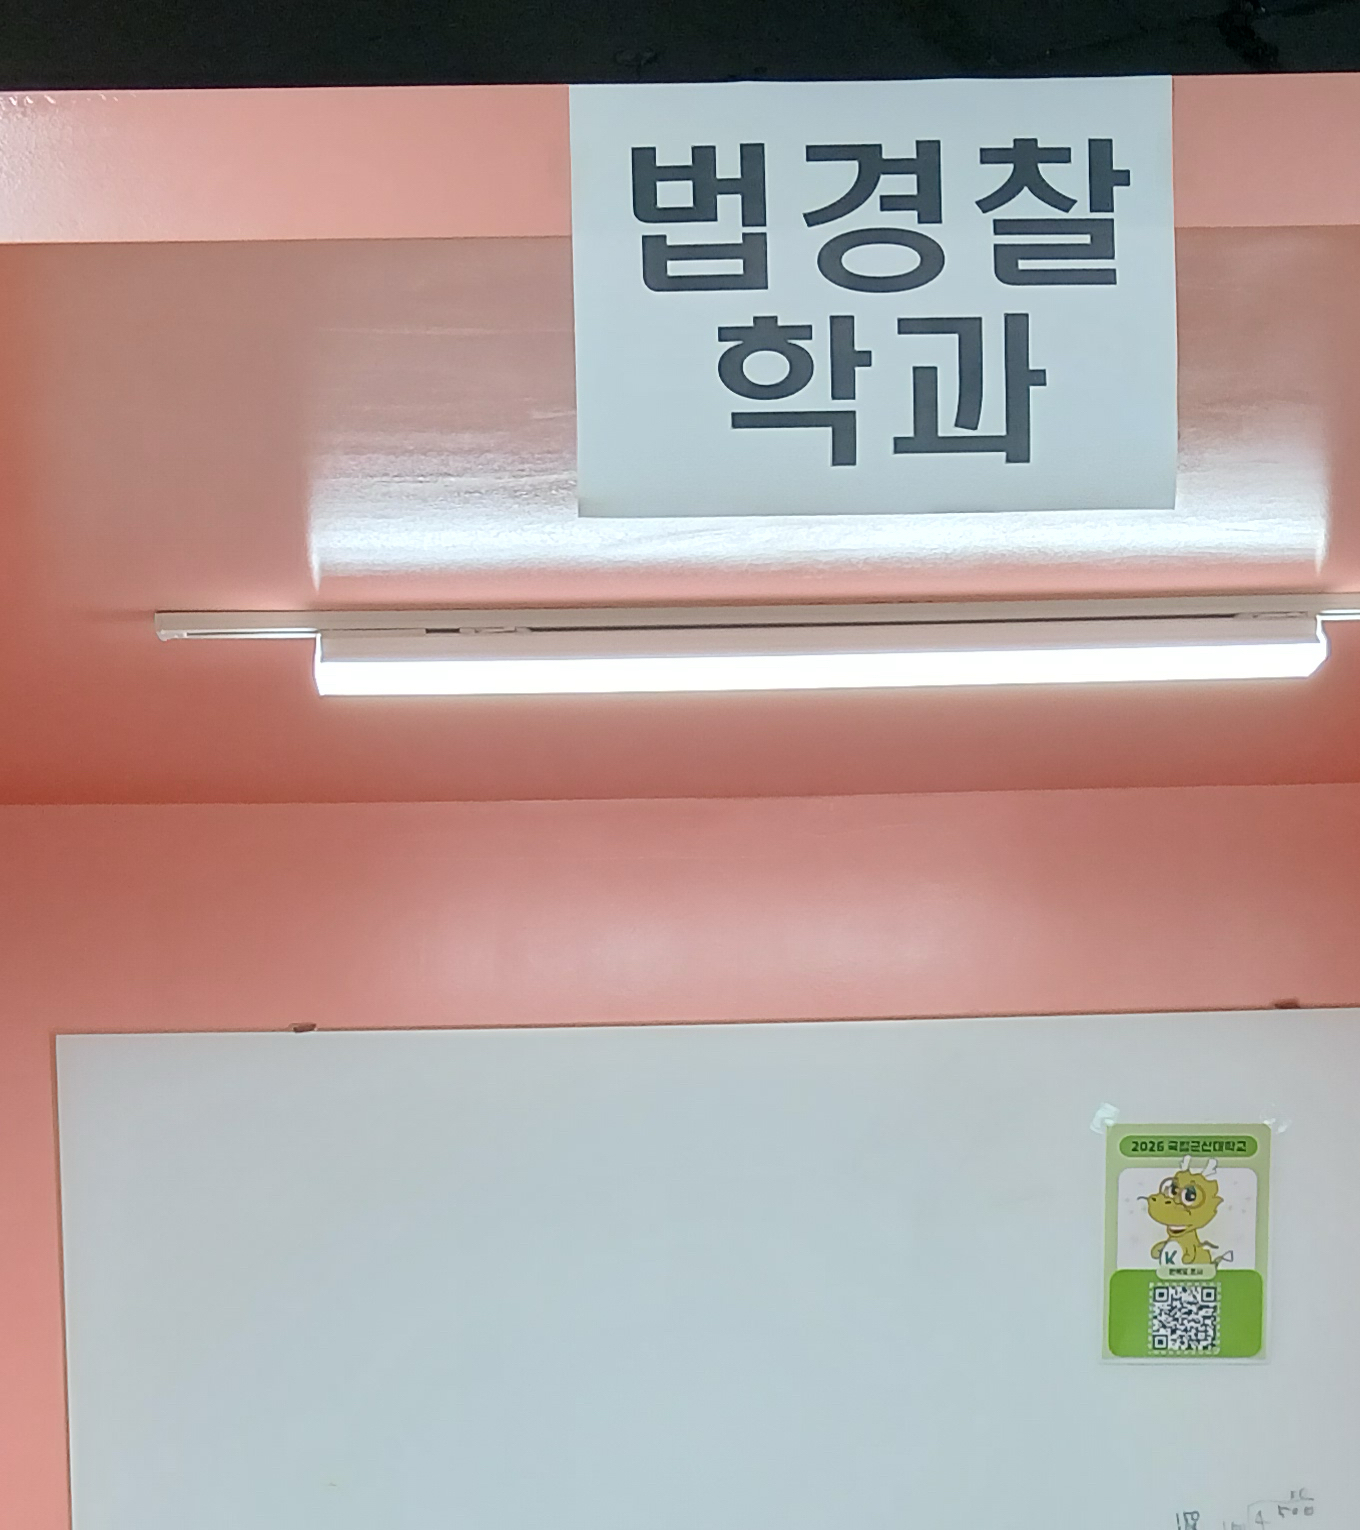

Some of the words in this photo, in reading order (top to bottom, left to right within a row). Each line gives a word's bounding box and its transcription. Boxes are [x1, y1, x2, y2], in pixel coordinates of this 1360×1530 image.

[631, 137, 1131, 294] 법경찰
[716, 312, 1048, 468] 학과
[1131, 1141, 1165, 1152] 2026
[1167, 1140, 1247, 1153] 국립군산대학교
[1165, 1250, 1178, 1265] K
